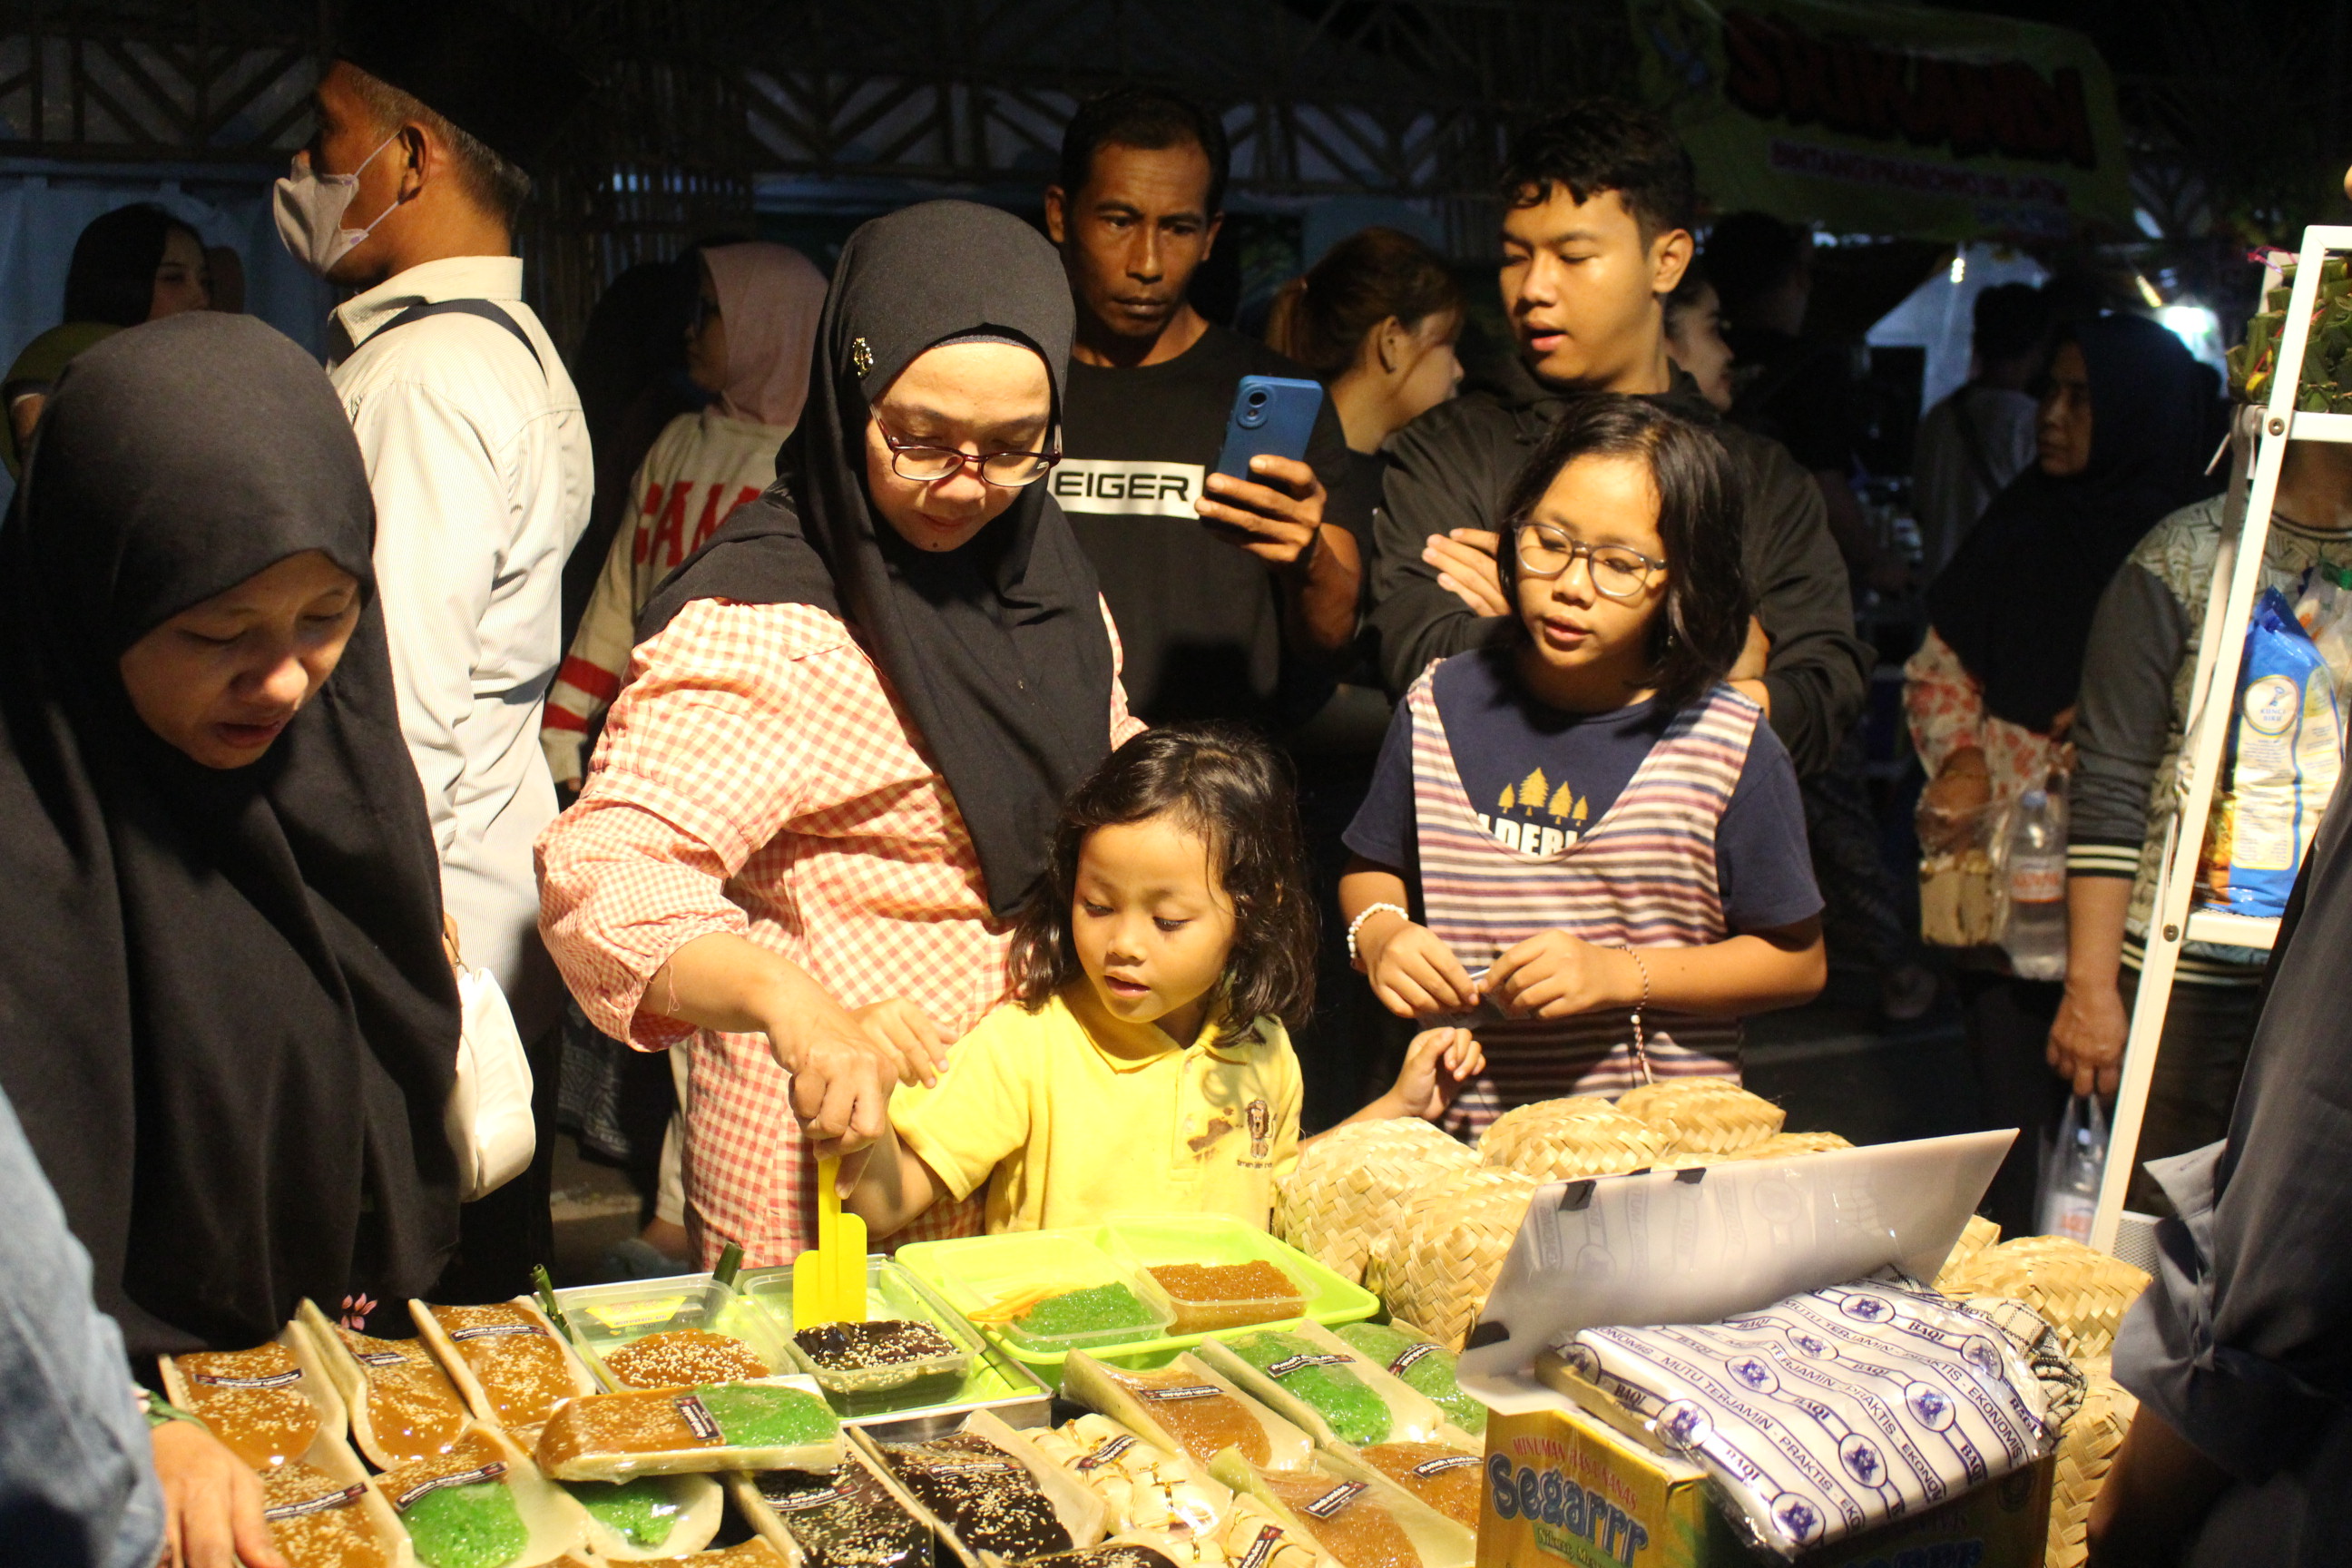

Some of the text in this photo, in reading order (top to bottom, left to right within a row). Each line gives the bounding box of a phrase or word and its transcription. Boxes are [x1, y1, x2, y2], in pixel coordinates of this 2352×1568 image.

[1054, 471, 1189, 502] EIGER
[1908, 1321, 1946, 1342] BAQI
[1661, 1356, 1704, 1383] MUTU
[1704, 1379, 1774, 1431] TERJAMIN
[1779, 1436, 1834, 1492] PRAKTIS
[1769, 1343, 1836, 1387] TERJAMIN
[1845, 1386, 1896, 1435] PRAKTIS
[1784, 1299, 1823, 1322] MUTU
[1825, 1321, 1895, 1353] TERJAMIN
[1967, 1387, 2024, 1461] EKONOMIS
[1792, 1397, 1832, 1420] BAQI
[1852, 1363, 1891, 1377] BAQI
[1960, 1444, 1986, 1483] BAQI
[1513, 1437, 1639, 1511] MINUMAN RASA NANAS
[1613, 1383, 1761, 1482] BAQI BAQI
[1488, 1453, 1649, 1568] Segarrr
